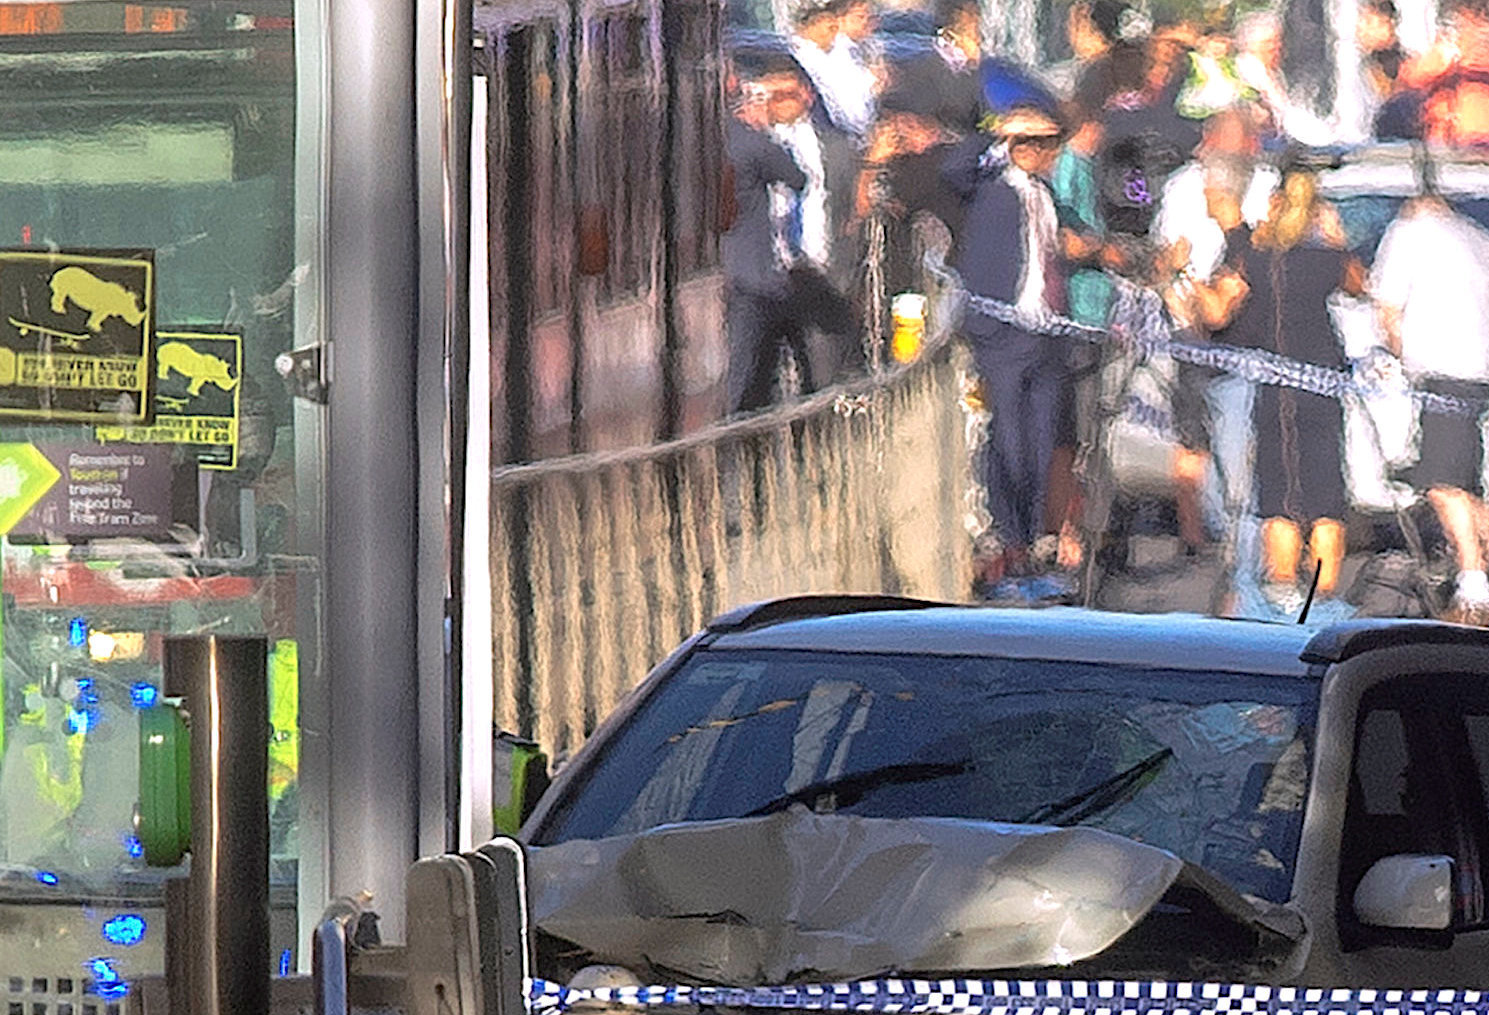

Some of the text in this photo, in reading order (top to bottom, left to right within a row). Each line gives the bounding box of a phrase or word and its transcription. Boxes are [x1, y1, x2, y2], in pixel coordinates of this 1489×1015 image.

[117, 374, 137, 388] GO
[214, 431, 229, 442] GO
[69, 453, 145, 467] Remember to
[112, 498, 133, 509] the
[98, 511, 129, 525] Tram
